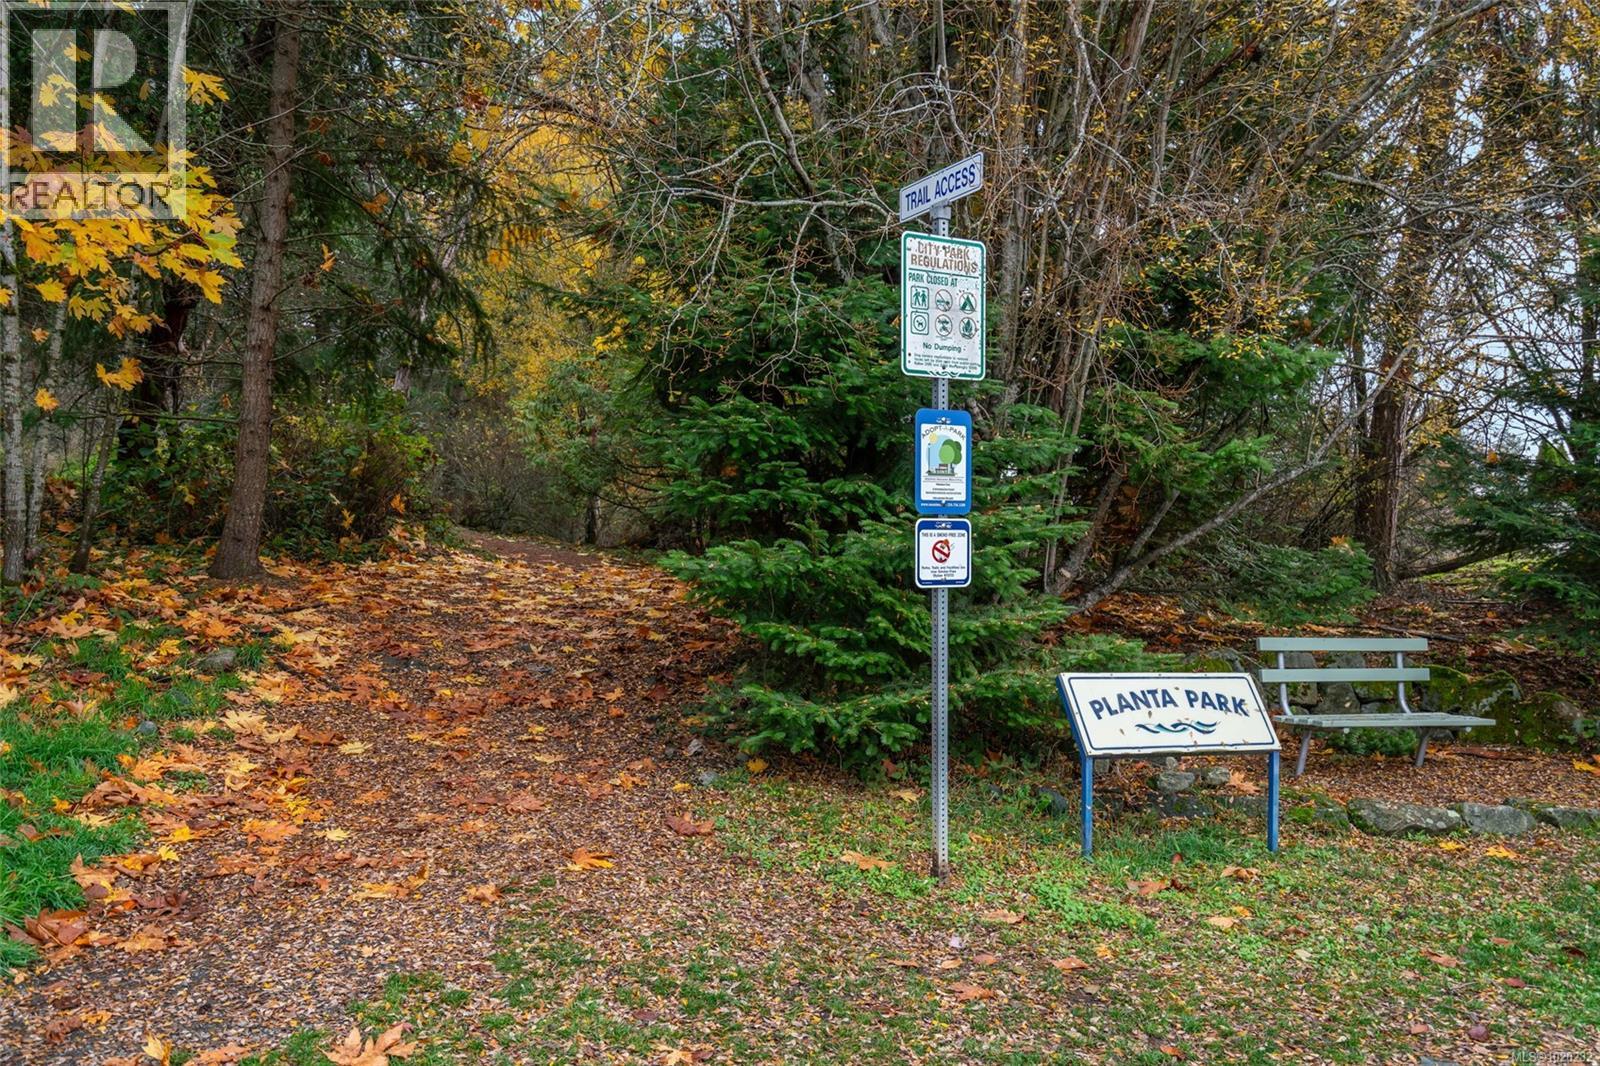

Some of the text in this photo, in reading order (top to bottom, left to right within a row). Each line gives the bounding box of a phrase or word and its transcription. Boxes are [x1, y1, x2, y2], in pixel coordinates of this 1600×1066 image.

[905, 164, 976, 211] TRAIL ACCESS
[918, 241, 970, 260] CITY PARK
[911, 254, 978, 273] REGULATIONS
[908, 272, 958, 287] PARK CLOSED AT
[923, 342, 962, 353] No Dumping
[1088, 689, 1250, 720] PLANTA PARK
